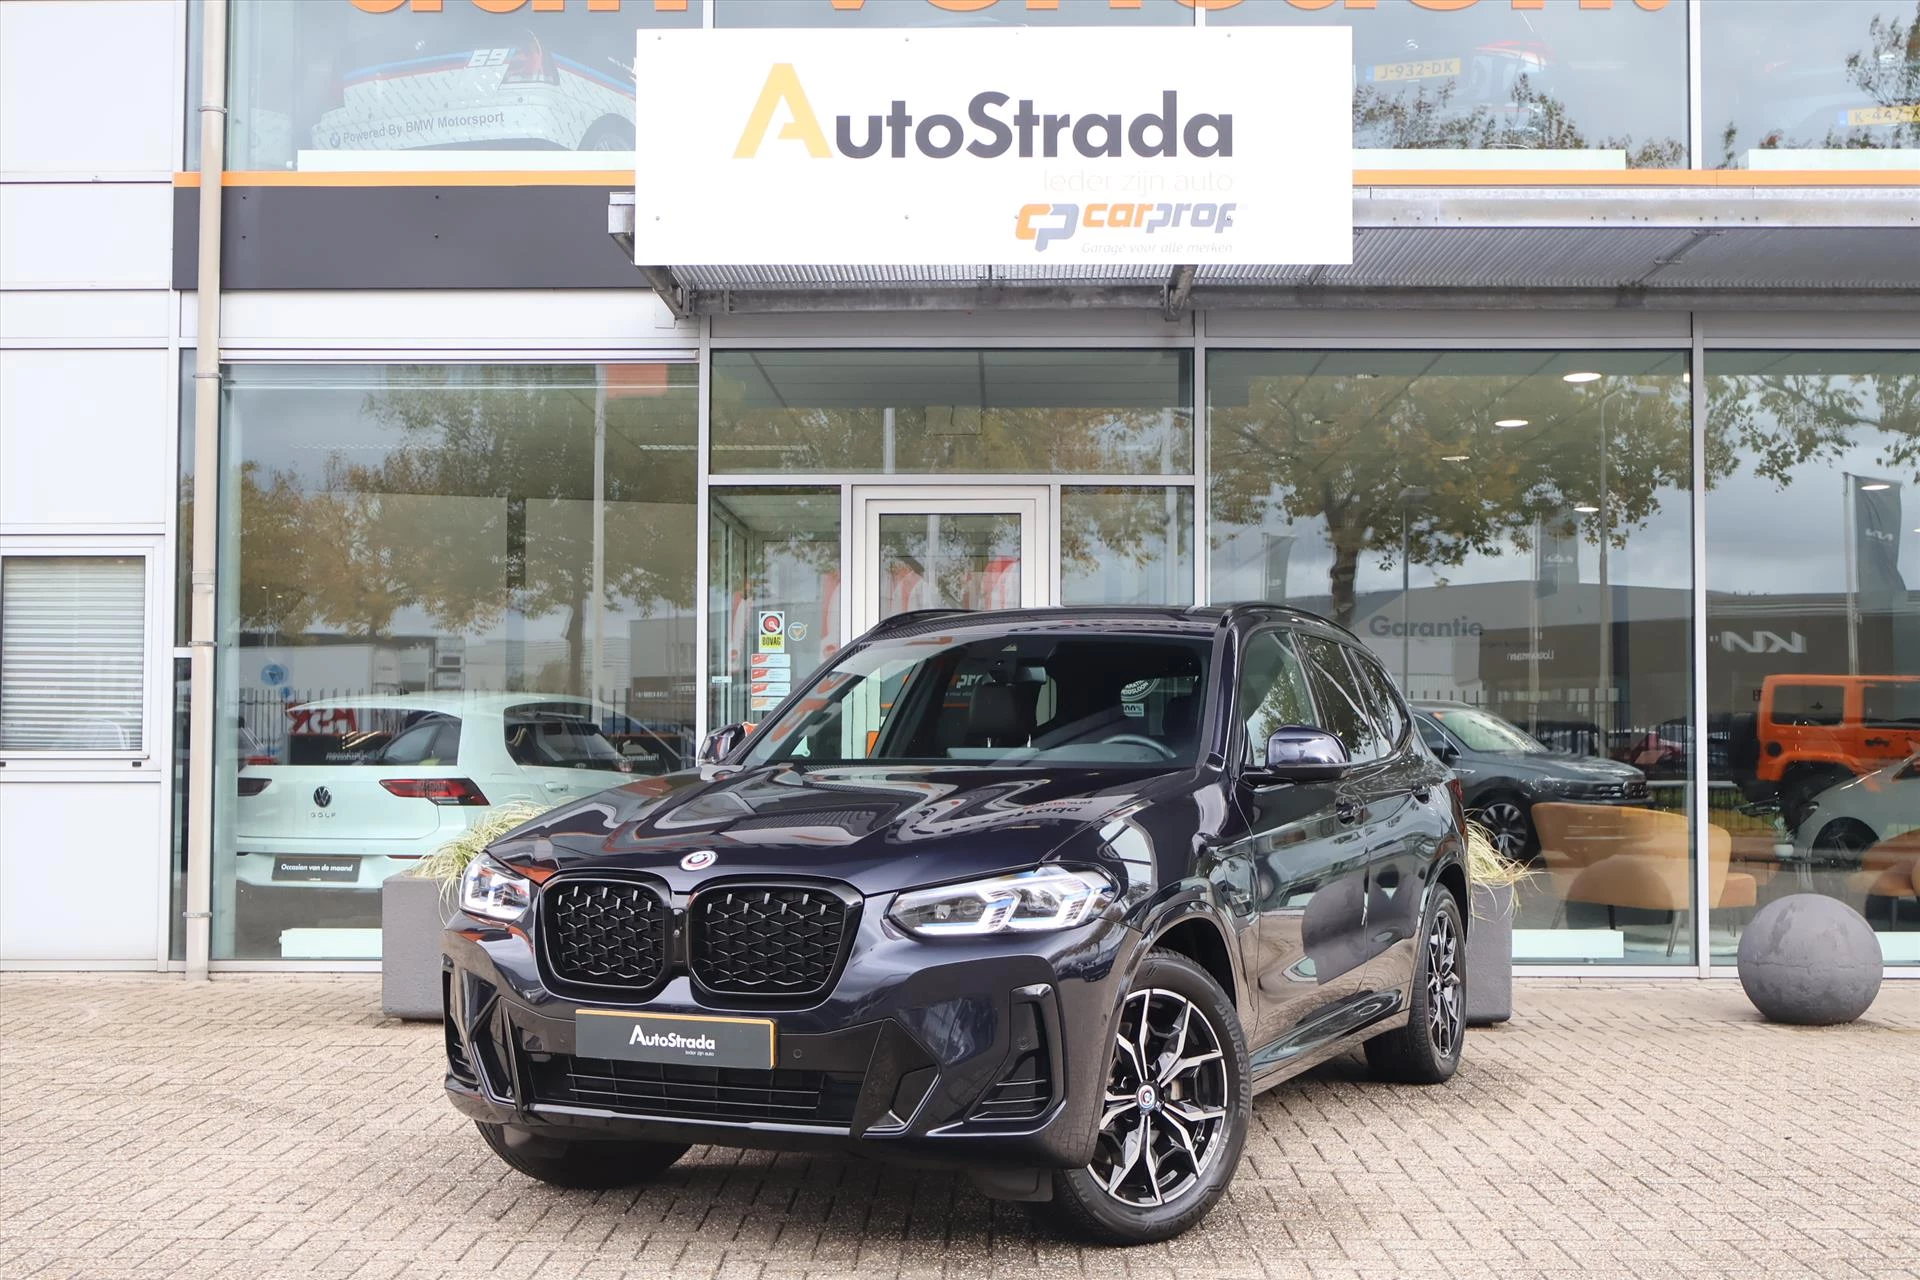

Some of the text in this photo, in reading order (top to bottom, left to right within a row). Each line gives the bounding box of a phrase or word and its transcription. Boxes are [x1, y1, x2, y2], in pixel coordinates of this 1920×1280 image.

[468, 48, 510, 67] 69
[1379, 60, 1454, 79] J-932-DK
[732, 62, 1234, 160] AutoStrada
[343, 111, 505, 144] Powered By BMW Motorsport
[1120, 170, 1165, 198] zijn
[1174, 170, 1234, 192] auto
[1081, 241, 1233, 256] Garage voor alle merken
[1368, 615, 1485, 638] Garantie
[310, 811, 337, 819] GOLF
[281, 863, 308, 872] Occasion
[321, 863, 330, 872] de
[330, 864, 354, 872] maand
[629, 1024, 716, 1050] AutoStrada
[1214, 1001, 1250, 1119] BRIDGESTONE
